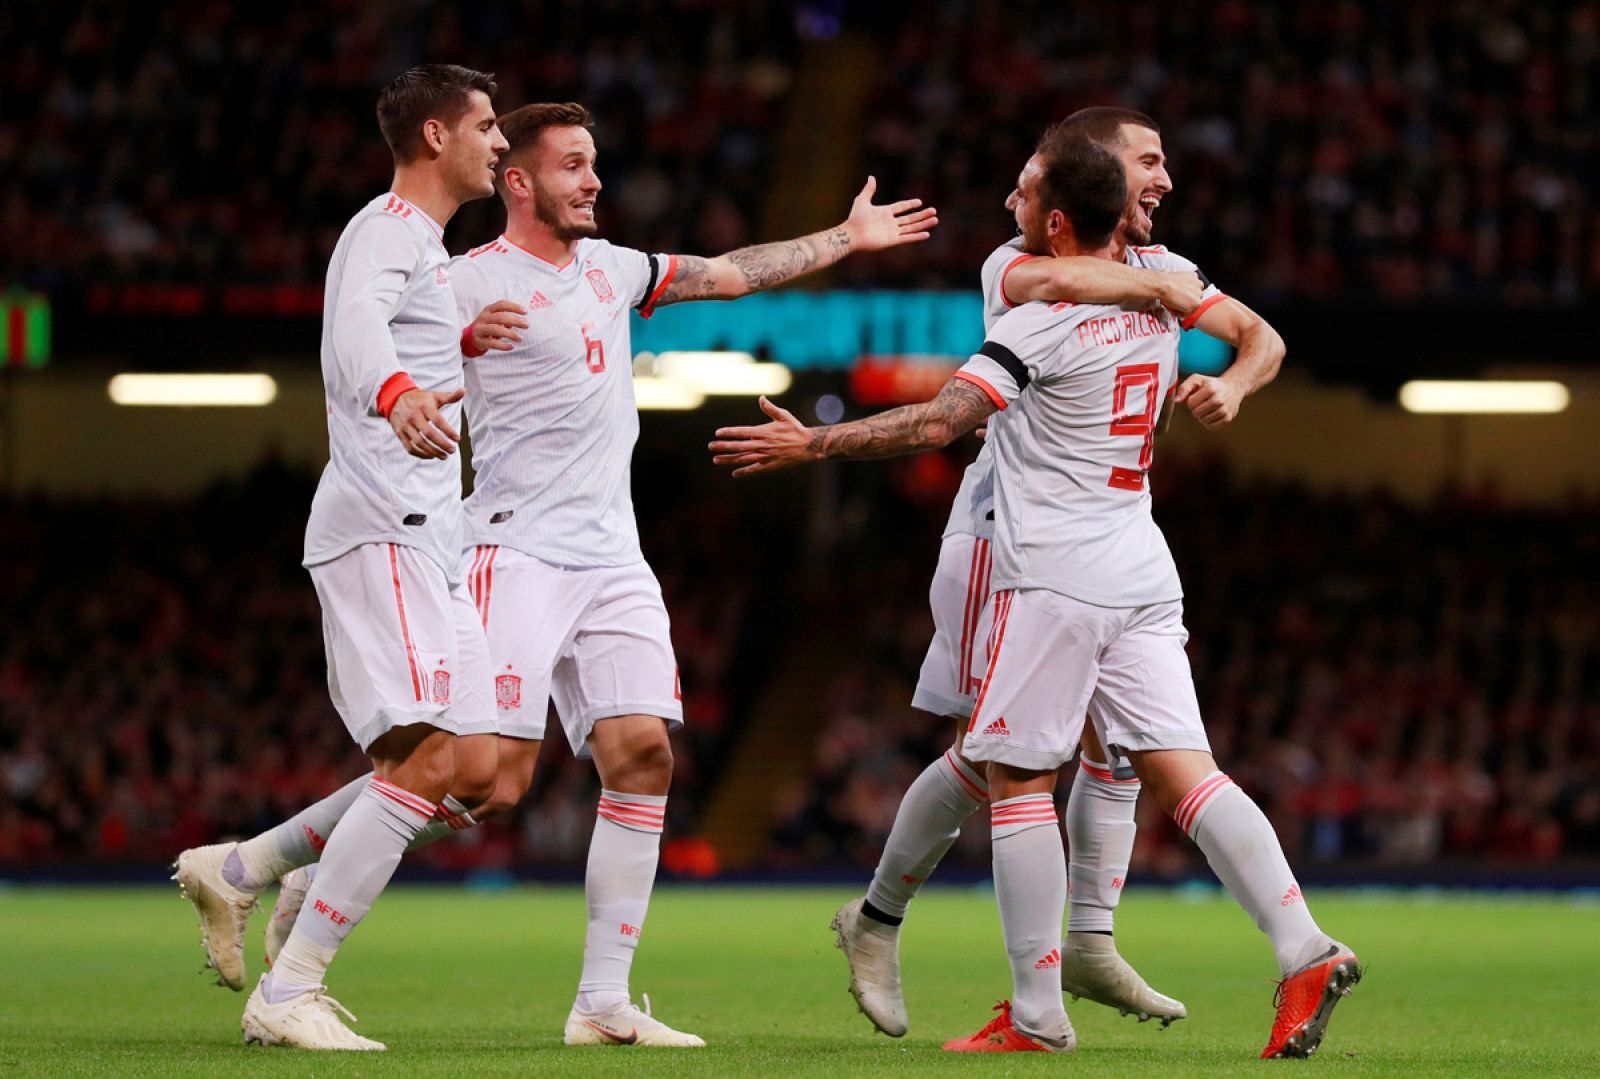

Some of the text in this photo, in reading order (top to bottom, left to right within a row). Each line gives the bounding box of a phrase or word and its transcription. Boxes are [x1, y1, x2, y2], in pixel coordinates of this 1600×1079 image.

[580, 321, 606, 374] 6
[1077, 317, 1121, 348] PACO
[1107, 363, 1160, 491] 9
[983, 727, 1010, 736] adidas
[314, 899, 350, 925] RFEF
